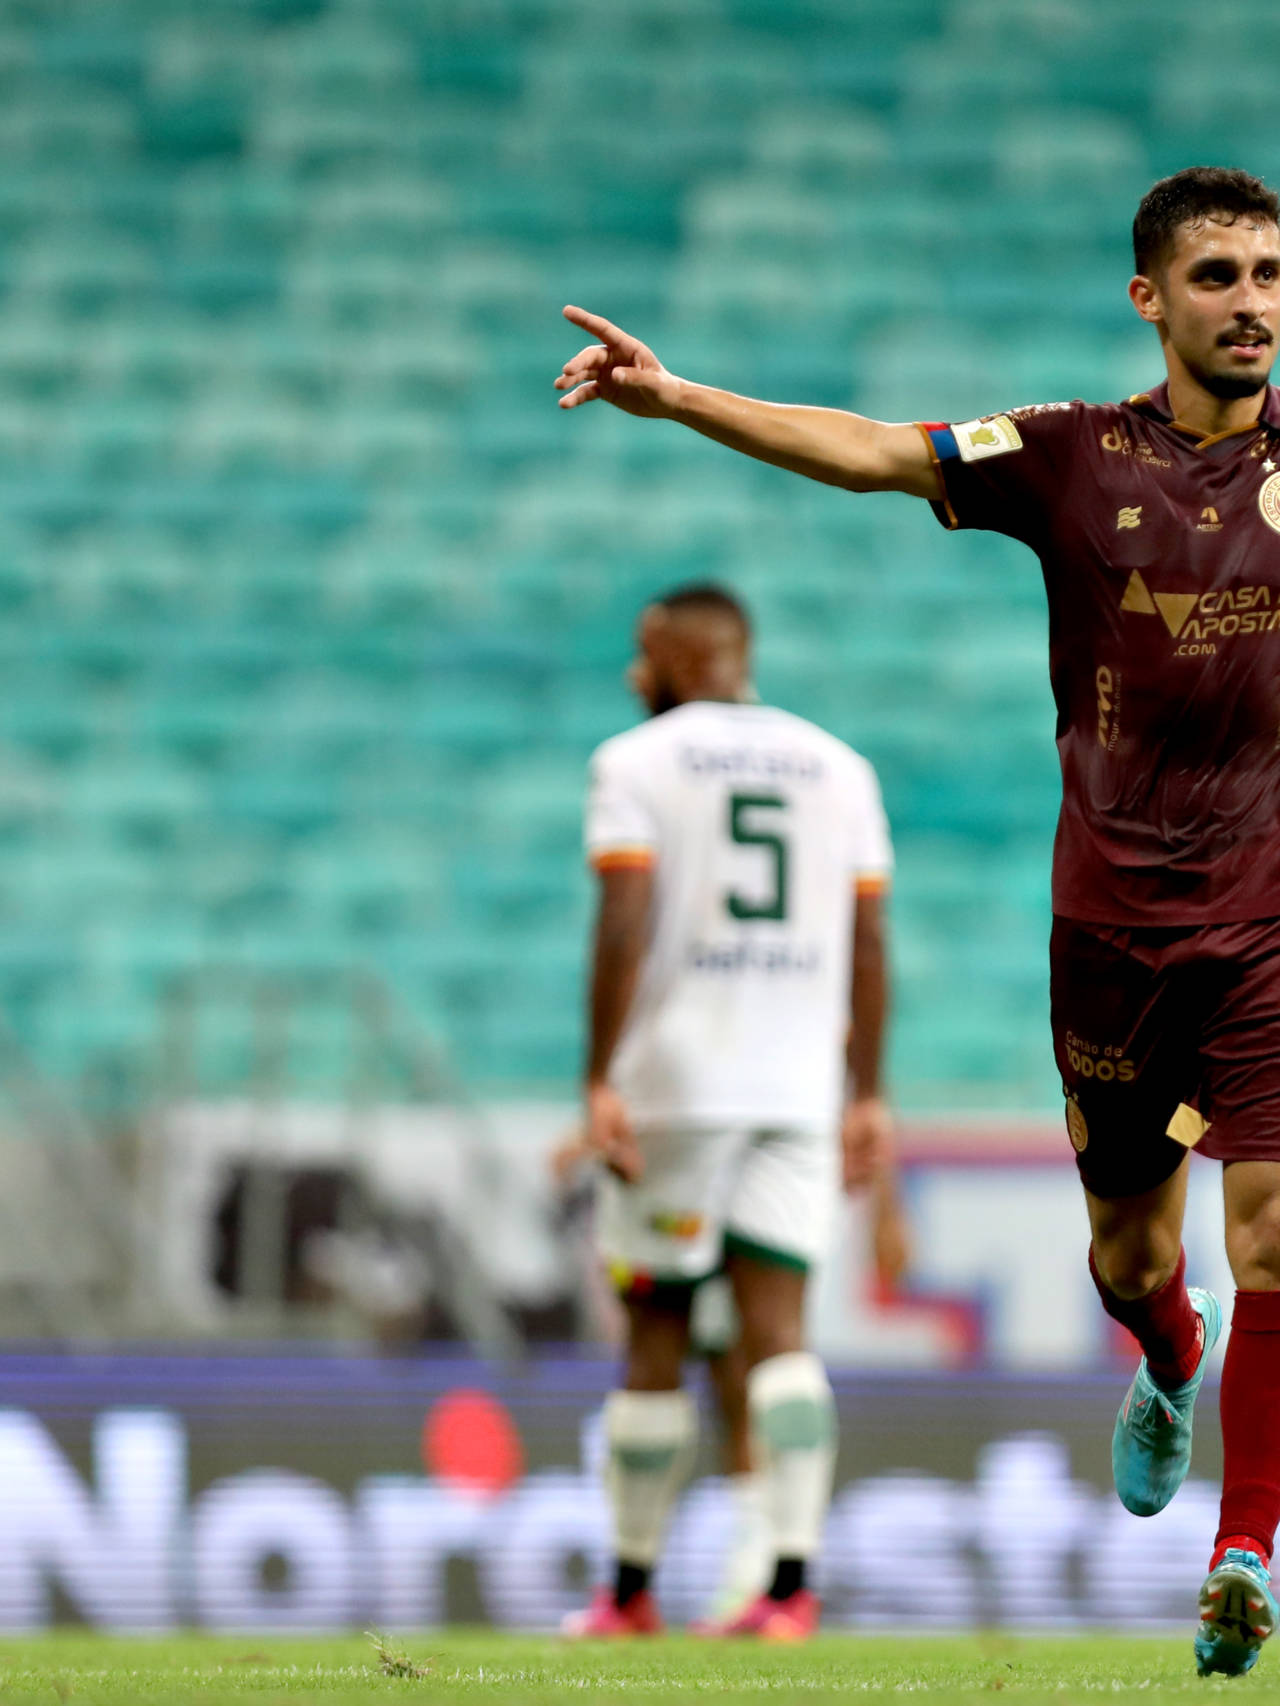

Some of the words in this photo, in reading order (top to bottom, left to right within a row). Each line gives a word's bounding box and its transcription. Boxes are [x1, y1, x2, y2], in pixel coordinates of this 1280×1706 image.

[1200, 585, 1271, 613] CASA
[727, 793, 786, 920] 5
[1104, 1044, 1122, 1057] de
